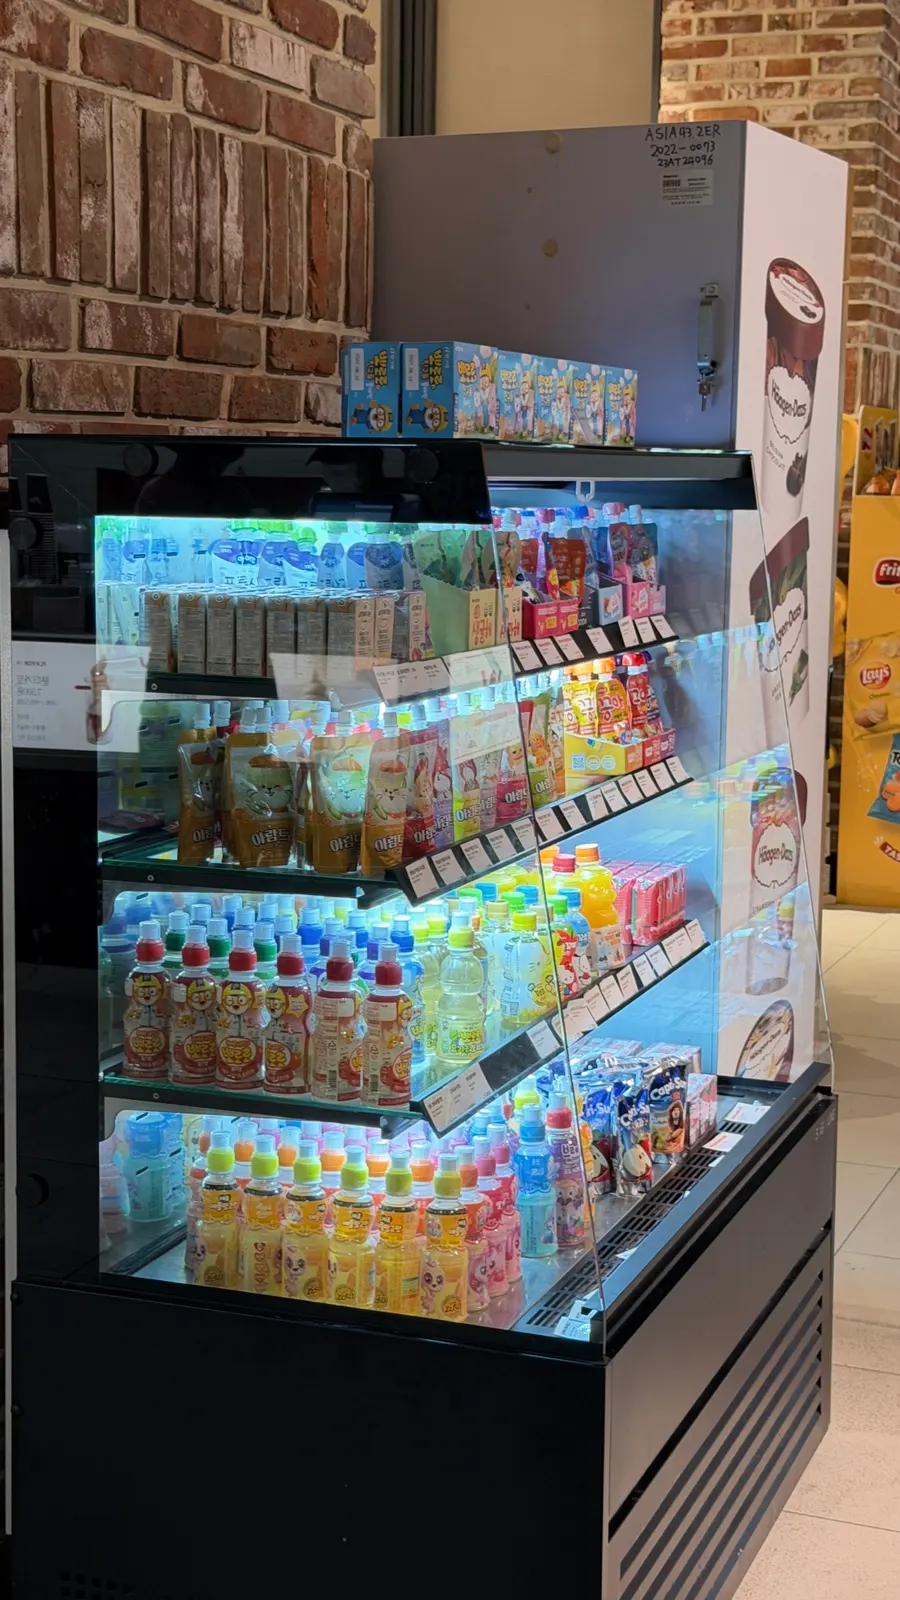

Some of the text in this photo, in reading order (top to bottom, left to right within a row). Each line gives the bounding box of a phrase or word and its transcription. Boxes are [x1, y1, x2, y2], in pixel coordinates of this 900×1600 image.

[771, 378, 807, 418] Häagen-Dazs
[758, 843, 793, 866] Häagen-Dazs
[336, 1290, 354, 1300] ZERO
[444, 1302, 461, 1313] ZERO
